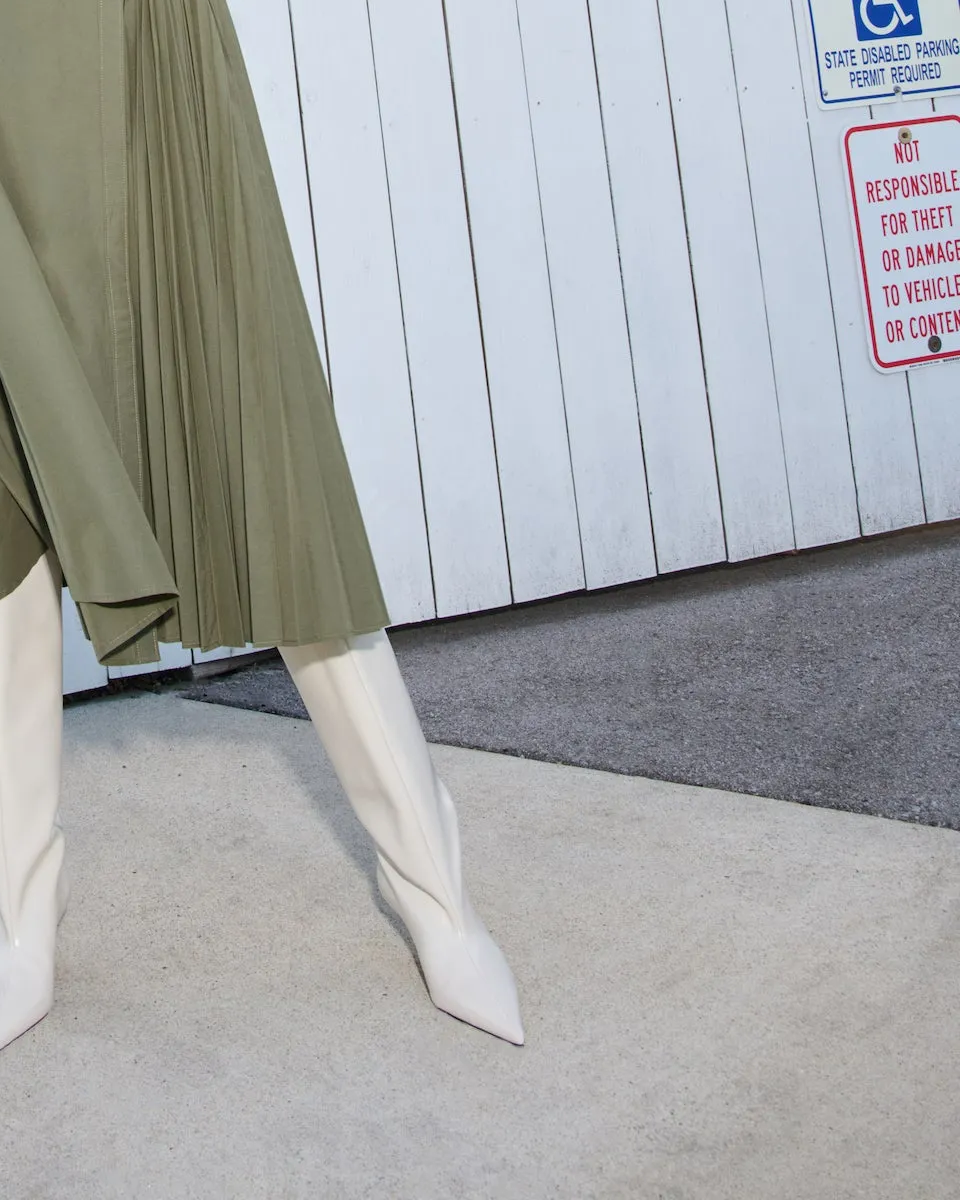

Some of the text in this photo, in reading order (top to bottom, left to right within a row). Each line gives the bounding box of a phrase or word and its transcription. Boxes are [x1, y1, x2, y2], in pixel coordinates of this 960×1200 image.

[824, 38, 960, 70] STATE DISABLED PARKING
[849, 62, 942, 89] PERMIT REQUIRED
[893, 140, 920, 164] NOT
[865, 170, 960, 203] RESPONSIBLE
[881, 205, 954, 237] FOR THEFT
[882, 248, 901, 272] OR
[882, 284, 900, 308] TO
[885, 320, 905, 343] OR
